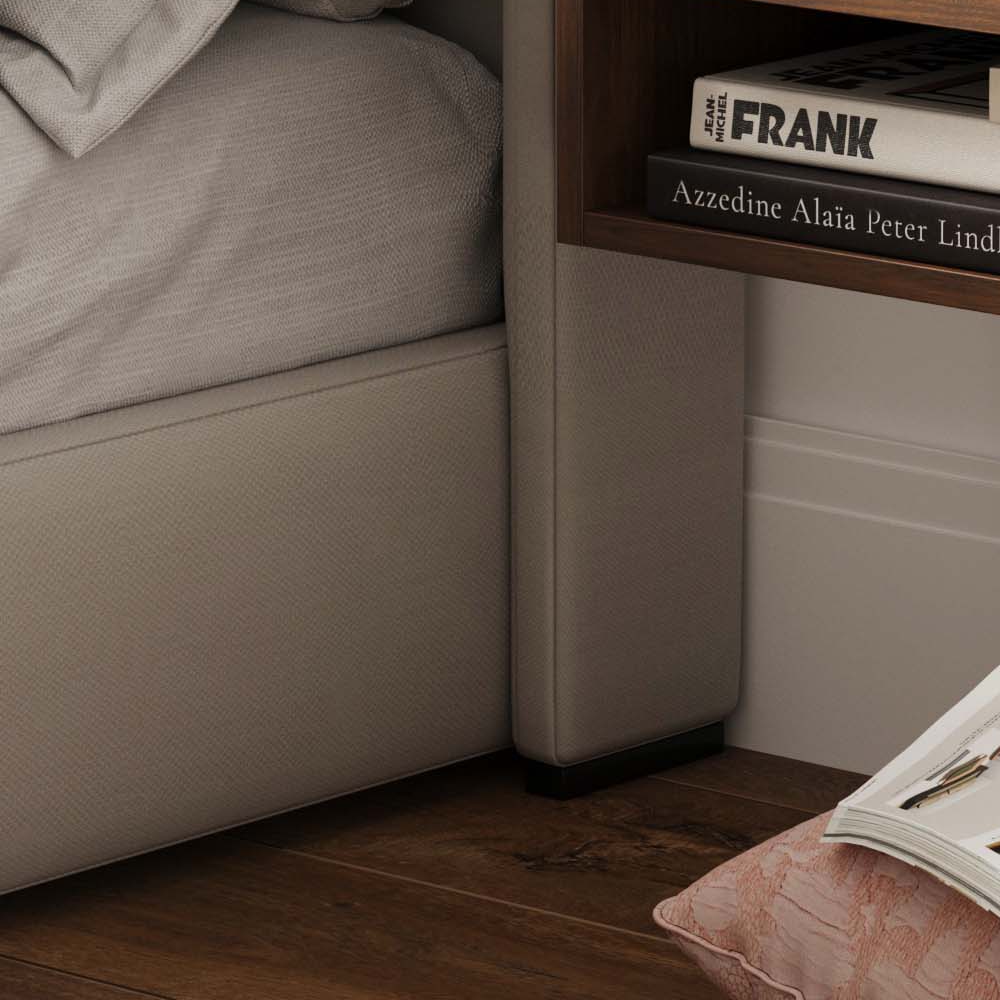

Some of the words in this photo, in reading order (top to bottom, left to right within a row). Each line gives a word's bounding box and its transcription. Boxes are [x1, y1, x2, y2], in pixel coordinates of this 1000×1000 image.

[704, 94, 716, 136] JEAN-
[715, 92, 728, 142] MICHEL
[731, 99, 878, 160] FRANK
[672, 179, 782, 219] Azzedine
[792, 197, 856, 231] Alaïa
[866, 209, 928, 242] Peter
